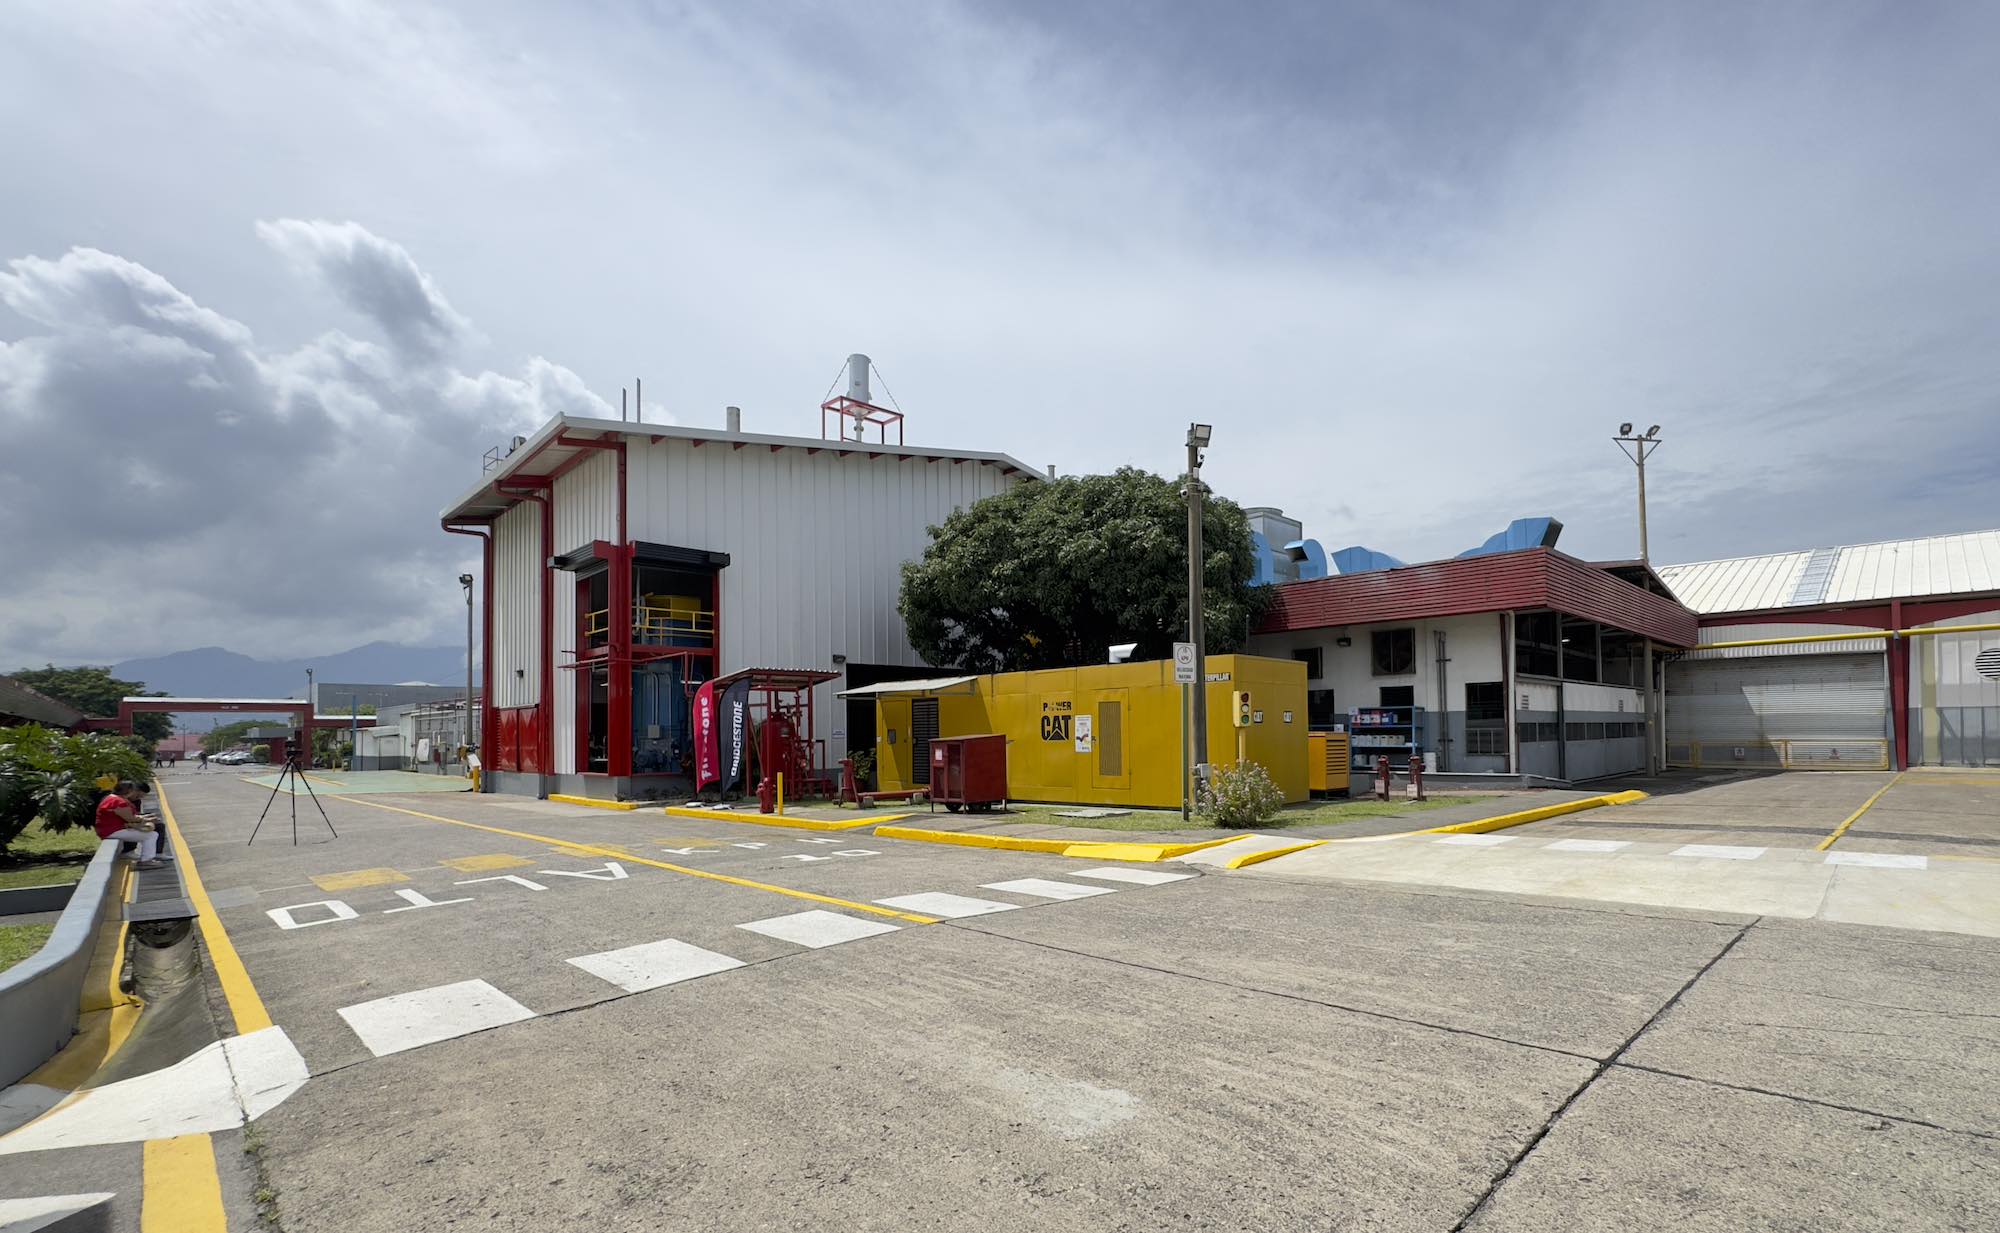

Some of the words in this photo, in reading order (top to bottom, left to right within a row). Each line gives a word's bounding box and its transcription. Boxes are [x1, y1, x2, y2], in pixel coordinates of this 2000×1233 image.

[1204, 673, 1230, 682] TERPILLAR
[1043, 701, 1072, 711] PWER
[731, 701, 743, 776] BRIDGESTONE
[1041, 715, 1072, 741] CAT
[265, 862, 630, 930] ALTO
